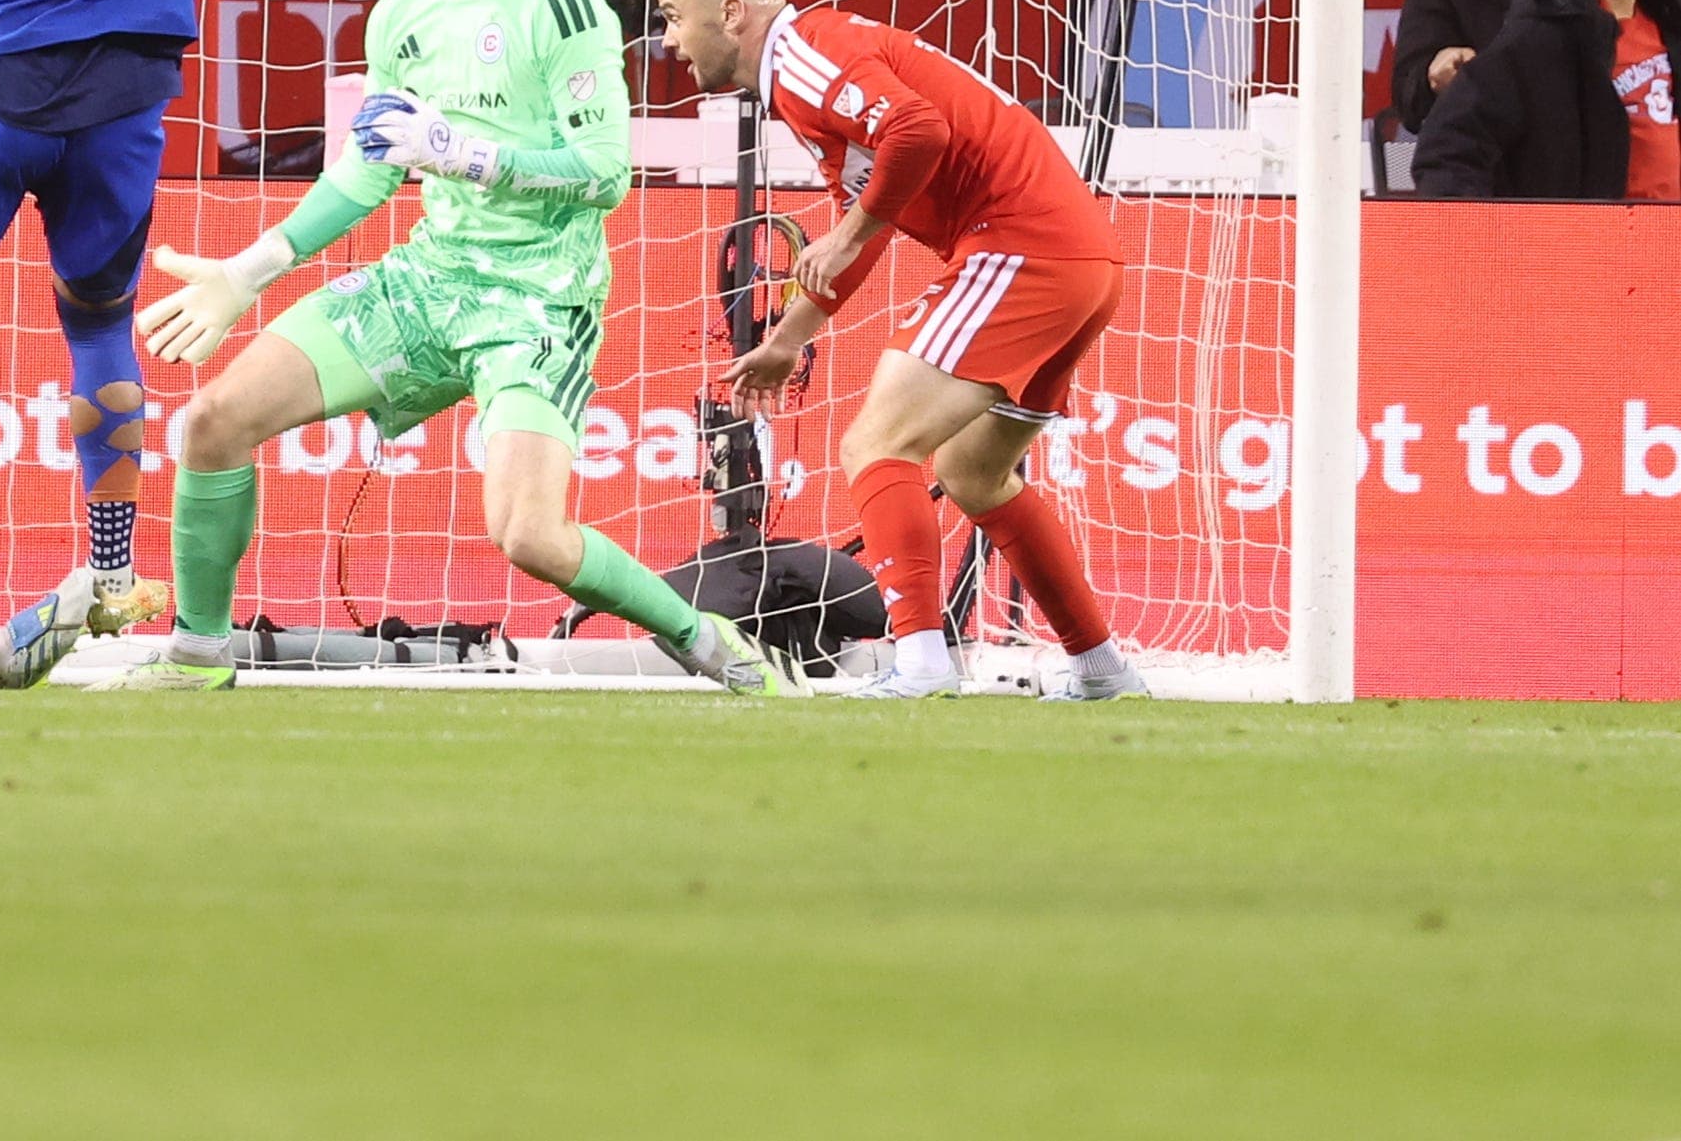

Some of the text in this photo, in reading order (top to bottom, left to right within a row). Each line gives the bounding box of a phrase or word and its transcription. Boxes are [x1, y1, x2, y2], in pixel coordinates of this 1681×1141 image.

[1024, 391, 1180, 490] t's
[1219, 404, 1424, 512] gt
[1455, 405, 1584, 497] to
